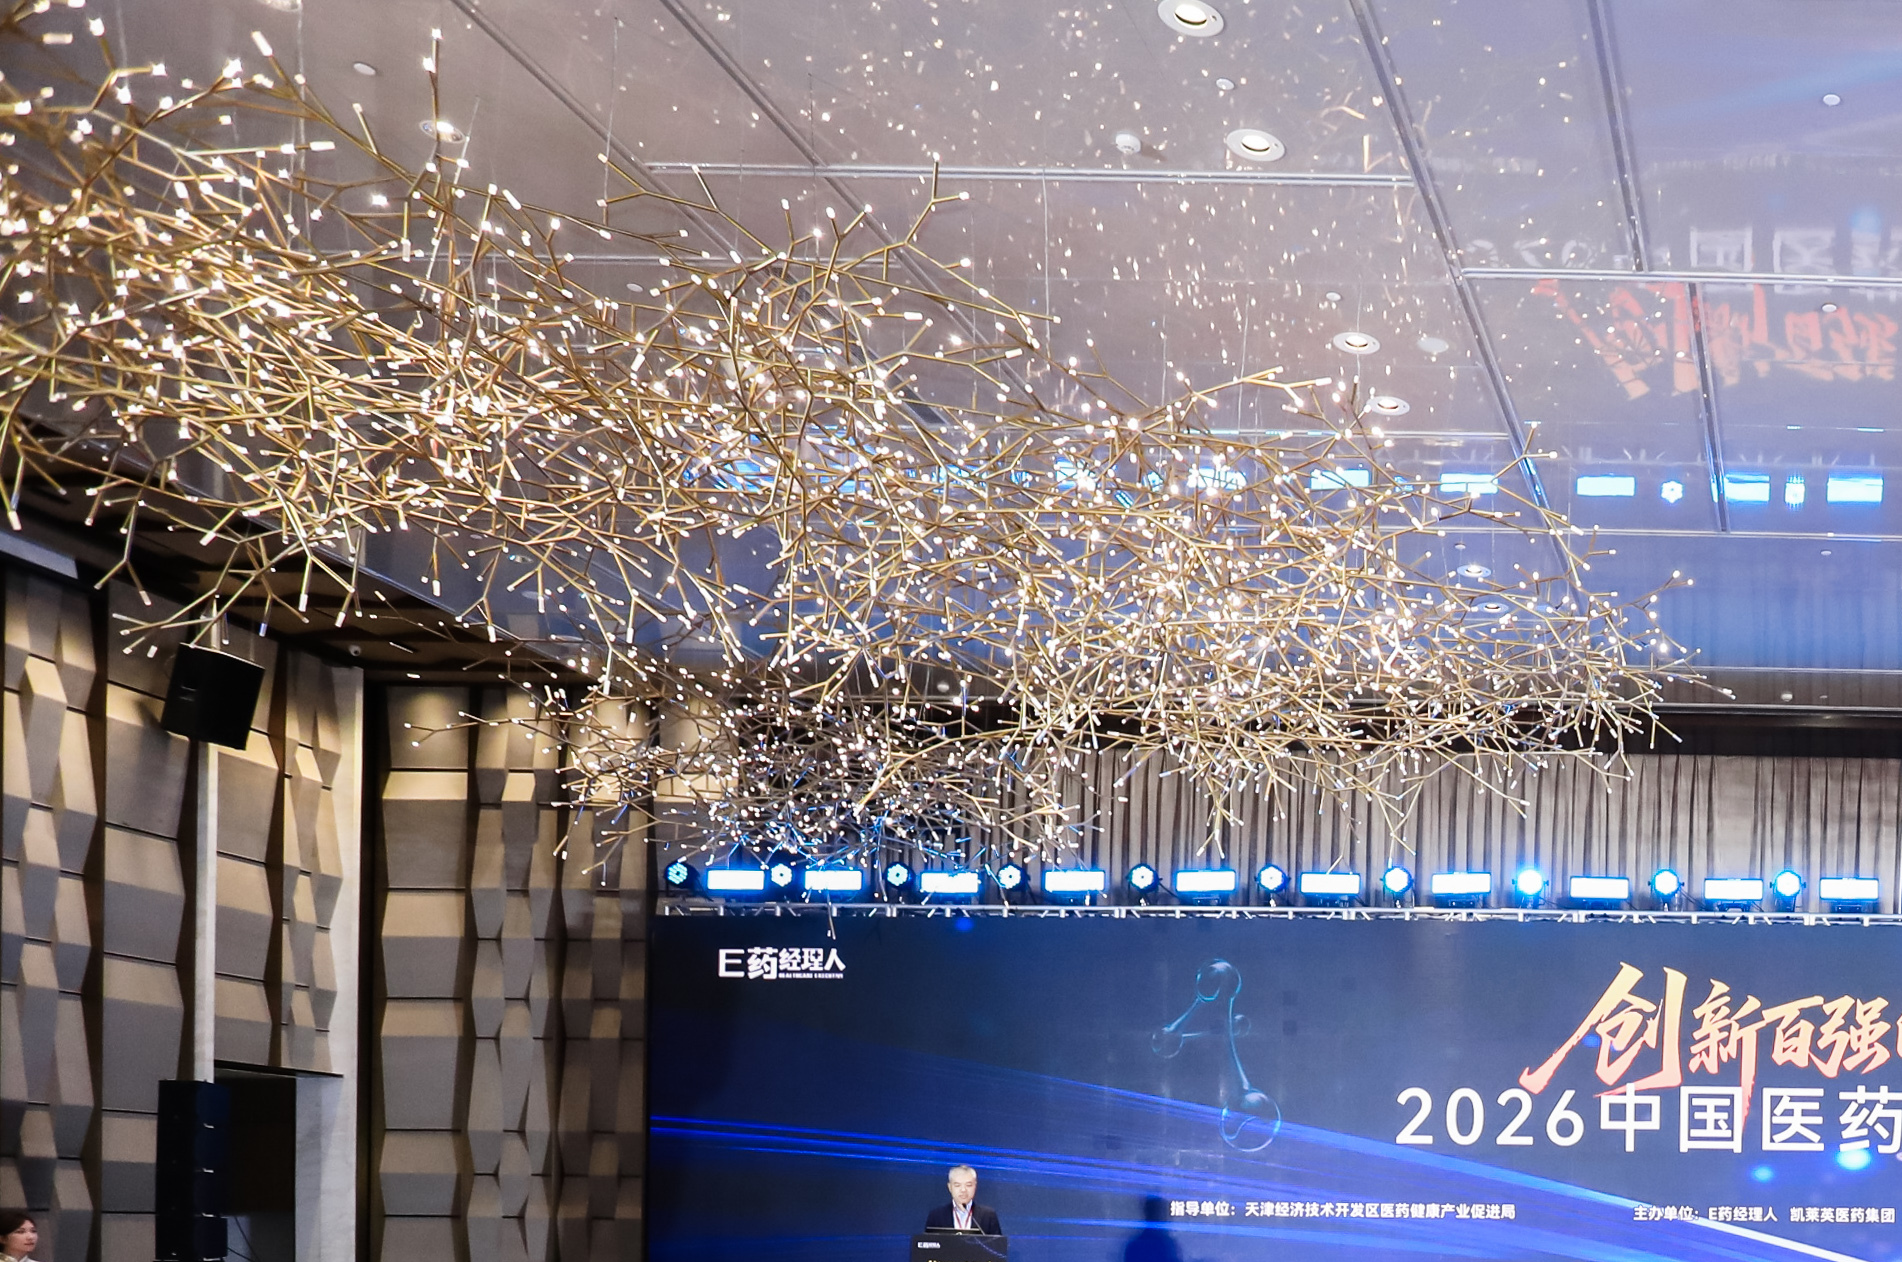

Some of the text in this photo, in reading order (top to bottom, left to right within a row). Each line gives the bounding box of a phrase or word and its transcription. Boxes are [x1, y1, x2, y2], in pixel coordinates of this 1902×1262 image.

[718, 947, 846, 980] E药经理人
[1790, 1207, 1895, 1223] 凯莱英医药集团
